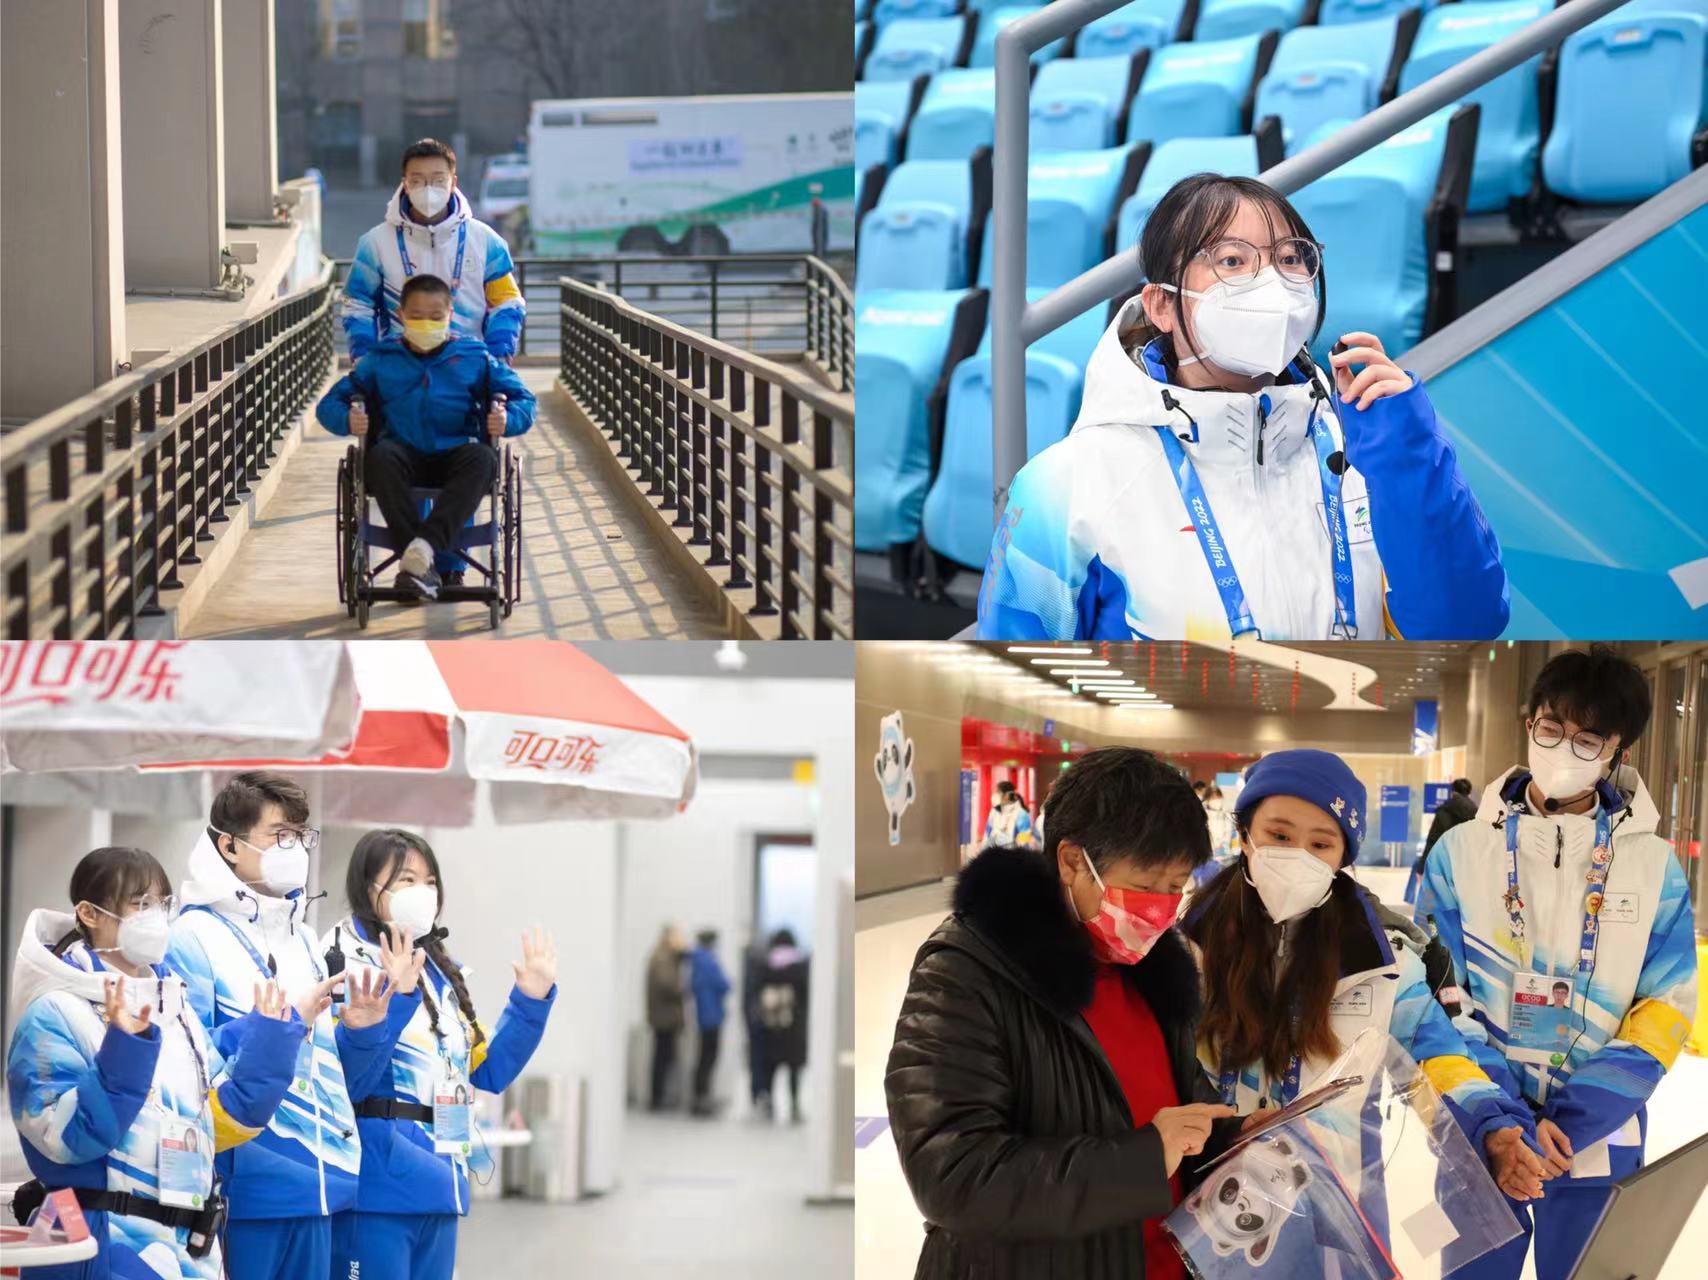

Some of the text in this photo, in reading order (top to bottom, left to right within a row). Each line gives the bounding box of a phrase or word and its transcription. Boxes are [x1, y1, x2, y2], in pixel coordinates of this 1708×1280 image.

[1192, 496, 1227, 568] BEIJING 2022
[1335, 533, 1346, 562] 2022
[504, 730, 605, 774] 可口可乐
